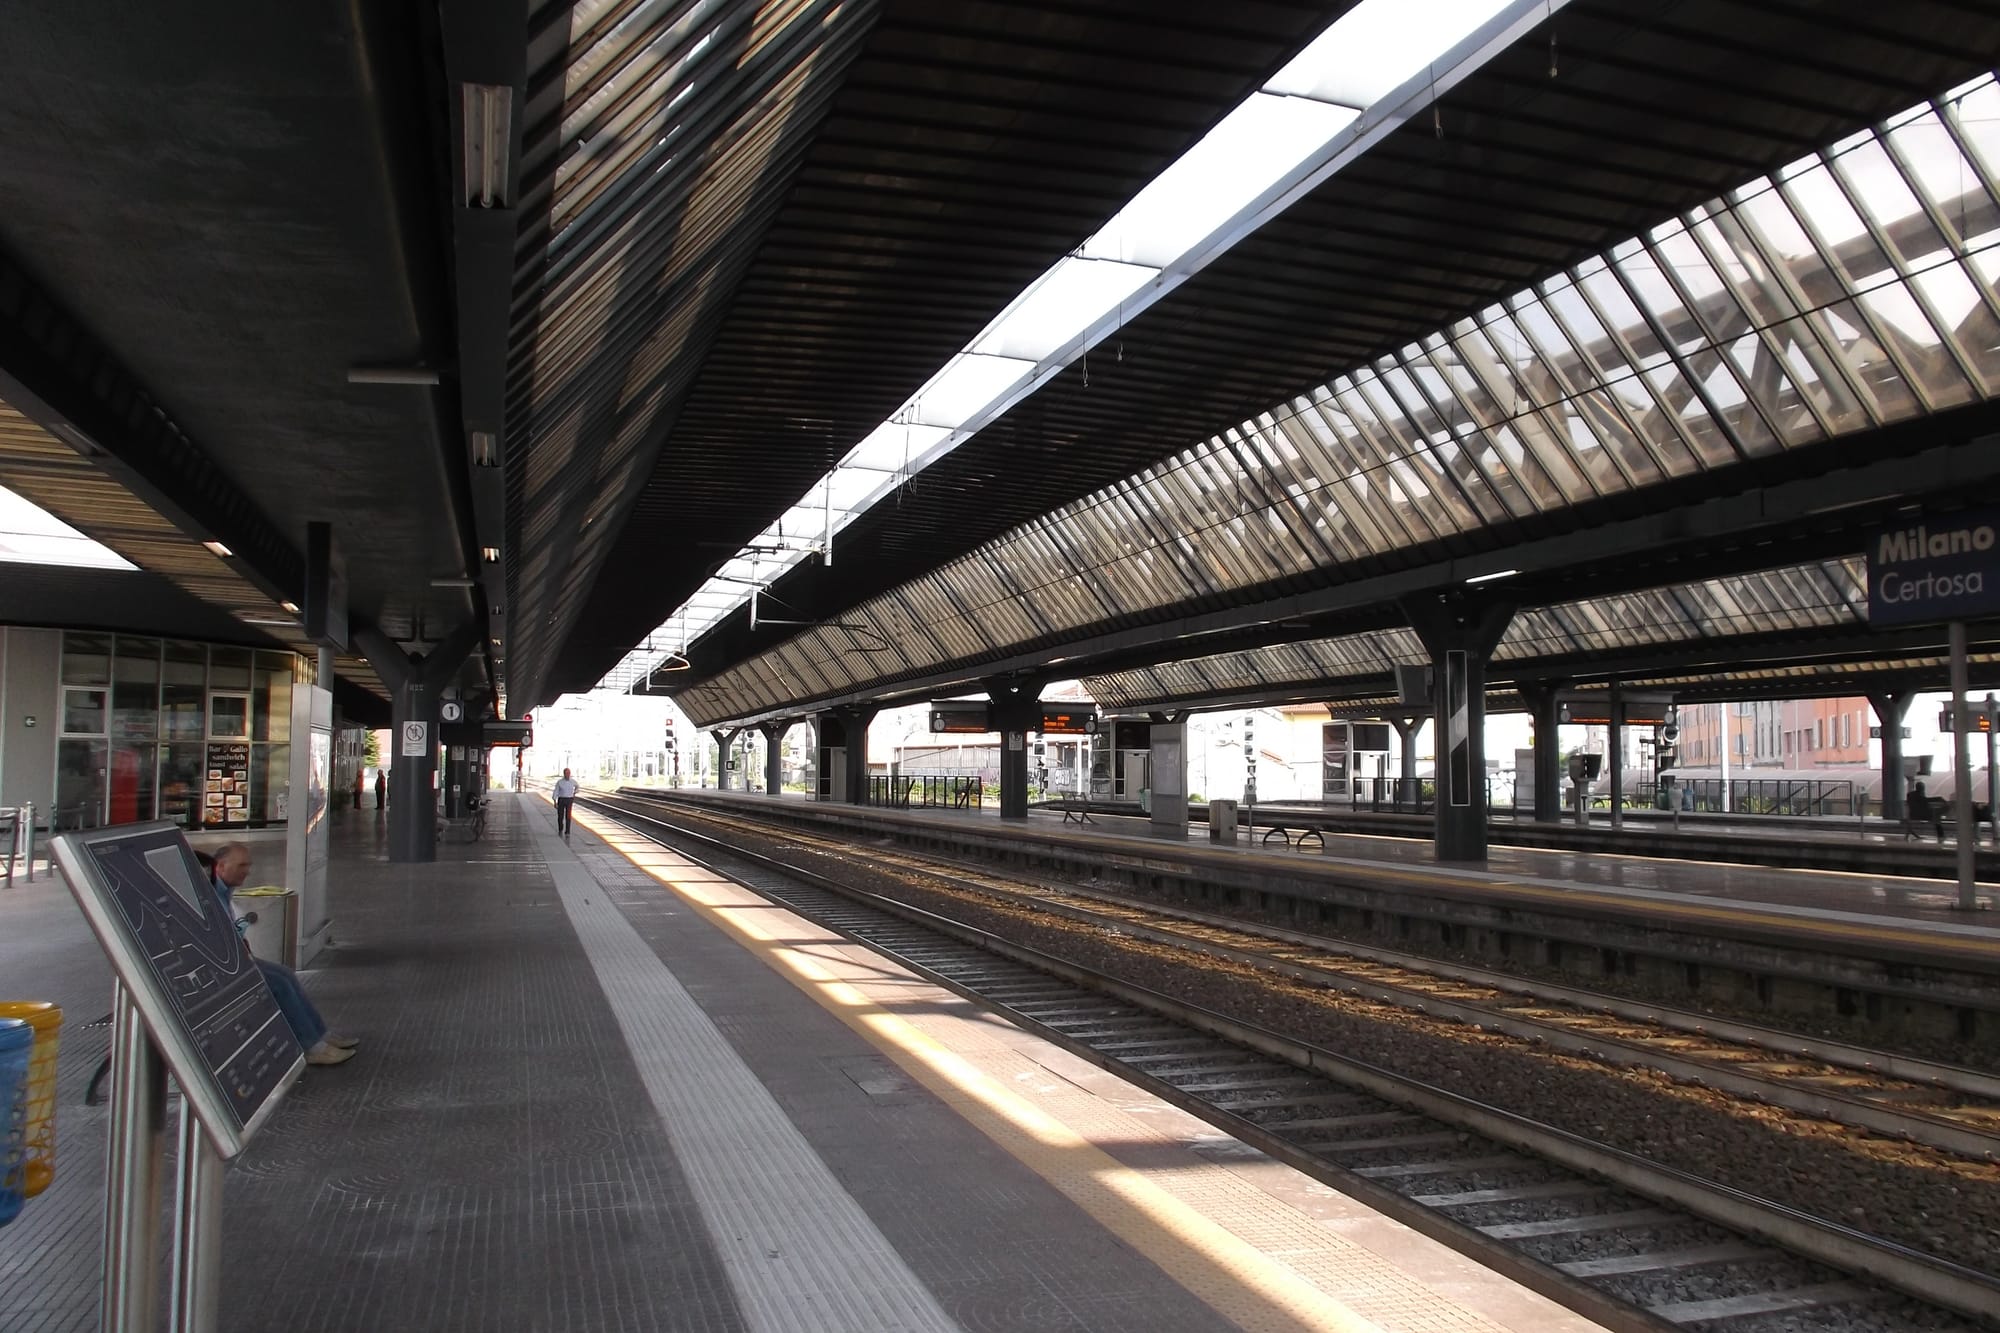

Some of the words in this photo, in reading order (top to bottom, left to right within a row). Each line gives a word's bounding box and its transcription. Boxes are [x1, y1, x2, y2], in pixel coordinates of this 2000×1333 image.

[1878, 525, 1996, 566] Milano
[1879, 571, 1984, 604] Certosa
[230, 745, 248, 753] Gallo
